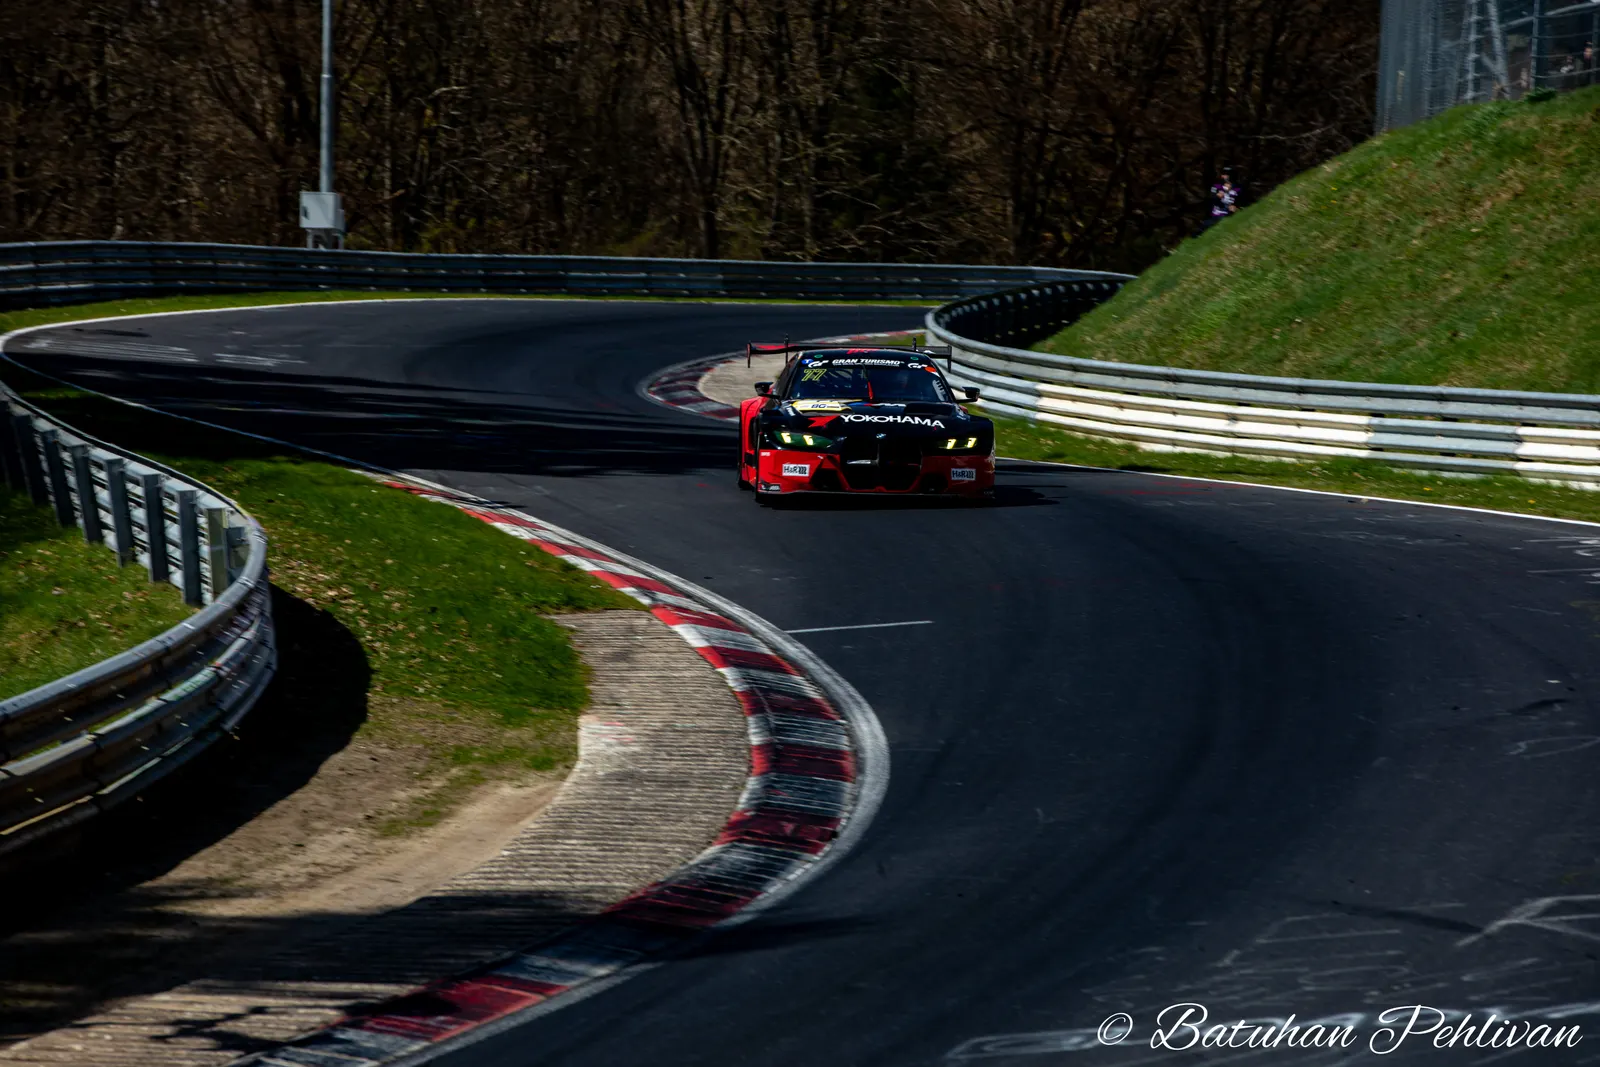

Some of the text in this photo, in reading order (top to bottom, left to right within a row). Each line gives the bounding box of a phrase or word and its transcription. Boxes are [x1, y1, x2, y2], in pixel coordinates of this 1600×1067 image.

[860, 358, 901, 366] TURISMO
[801, 368, 827, 381] 77
[840, 414, 945, 429] YOKOHAMA
